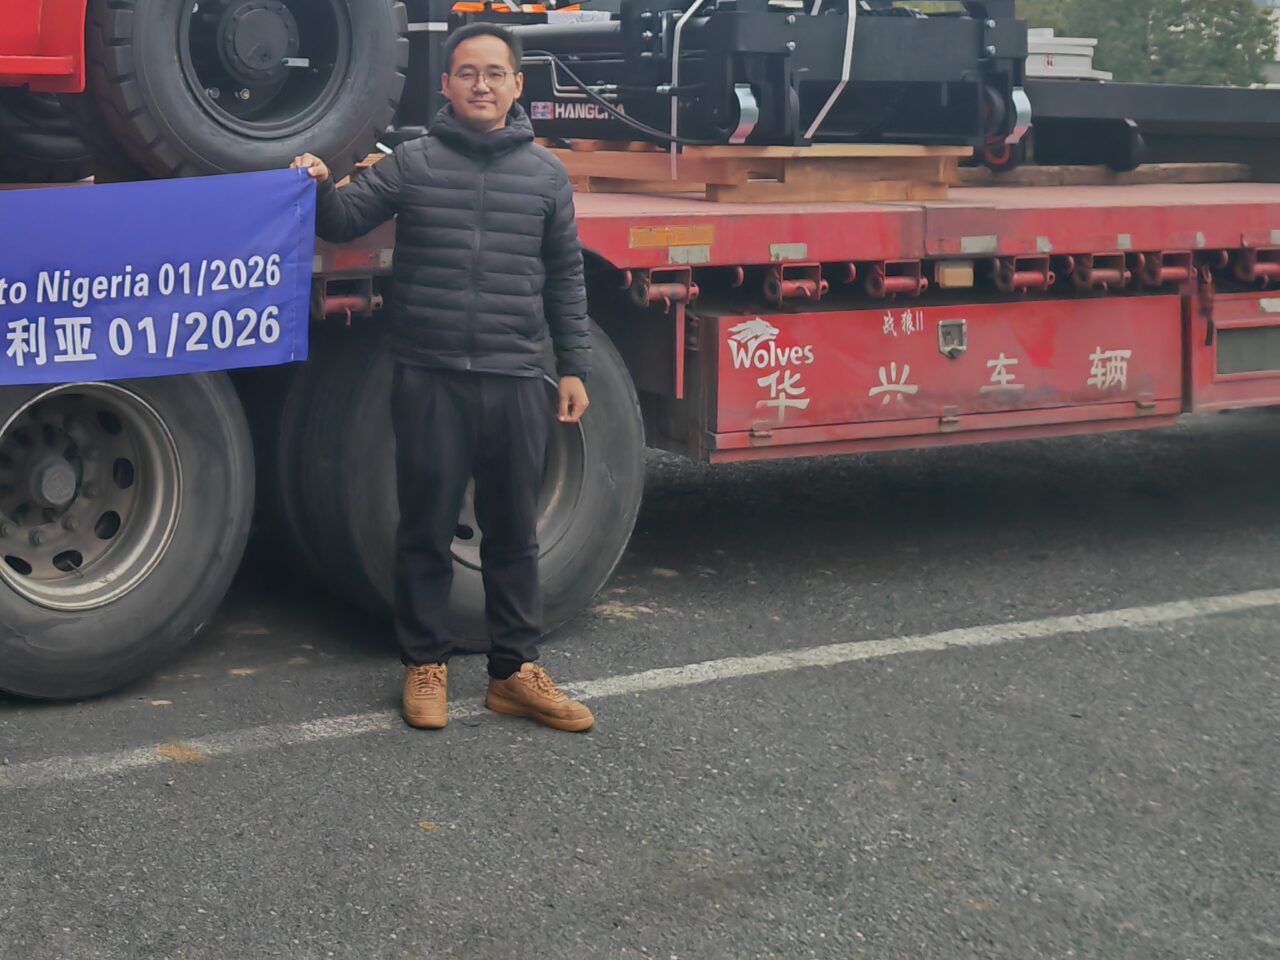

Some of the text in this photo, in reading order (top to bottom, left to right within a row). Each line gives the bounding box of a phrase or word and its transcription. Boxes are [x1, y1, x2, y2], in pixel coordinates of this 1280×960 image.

[36, 265, 150, 308] Nigeria
[158, 253, 281, 297] 01/2026
[108, 305, 281, 358] 01/2026
[727, 339, 815, 369] Wolves
